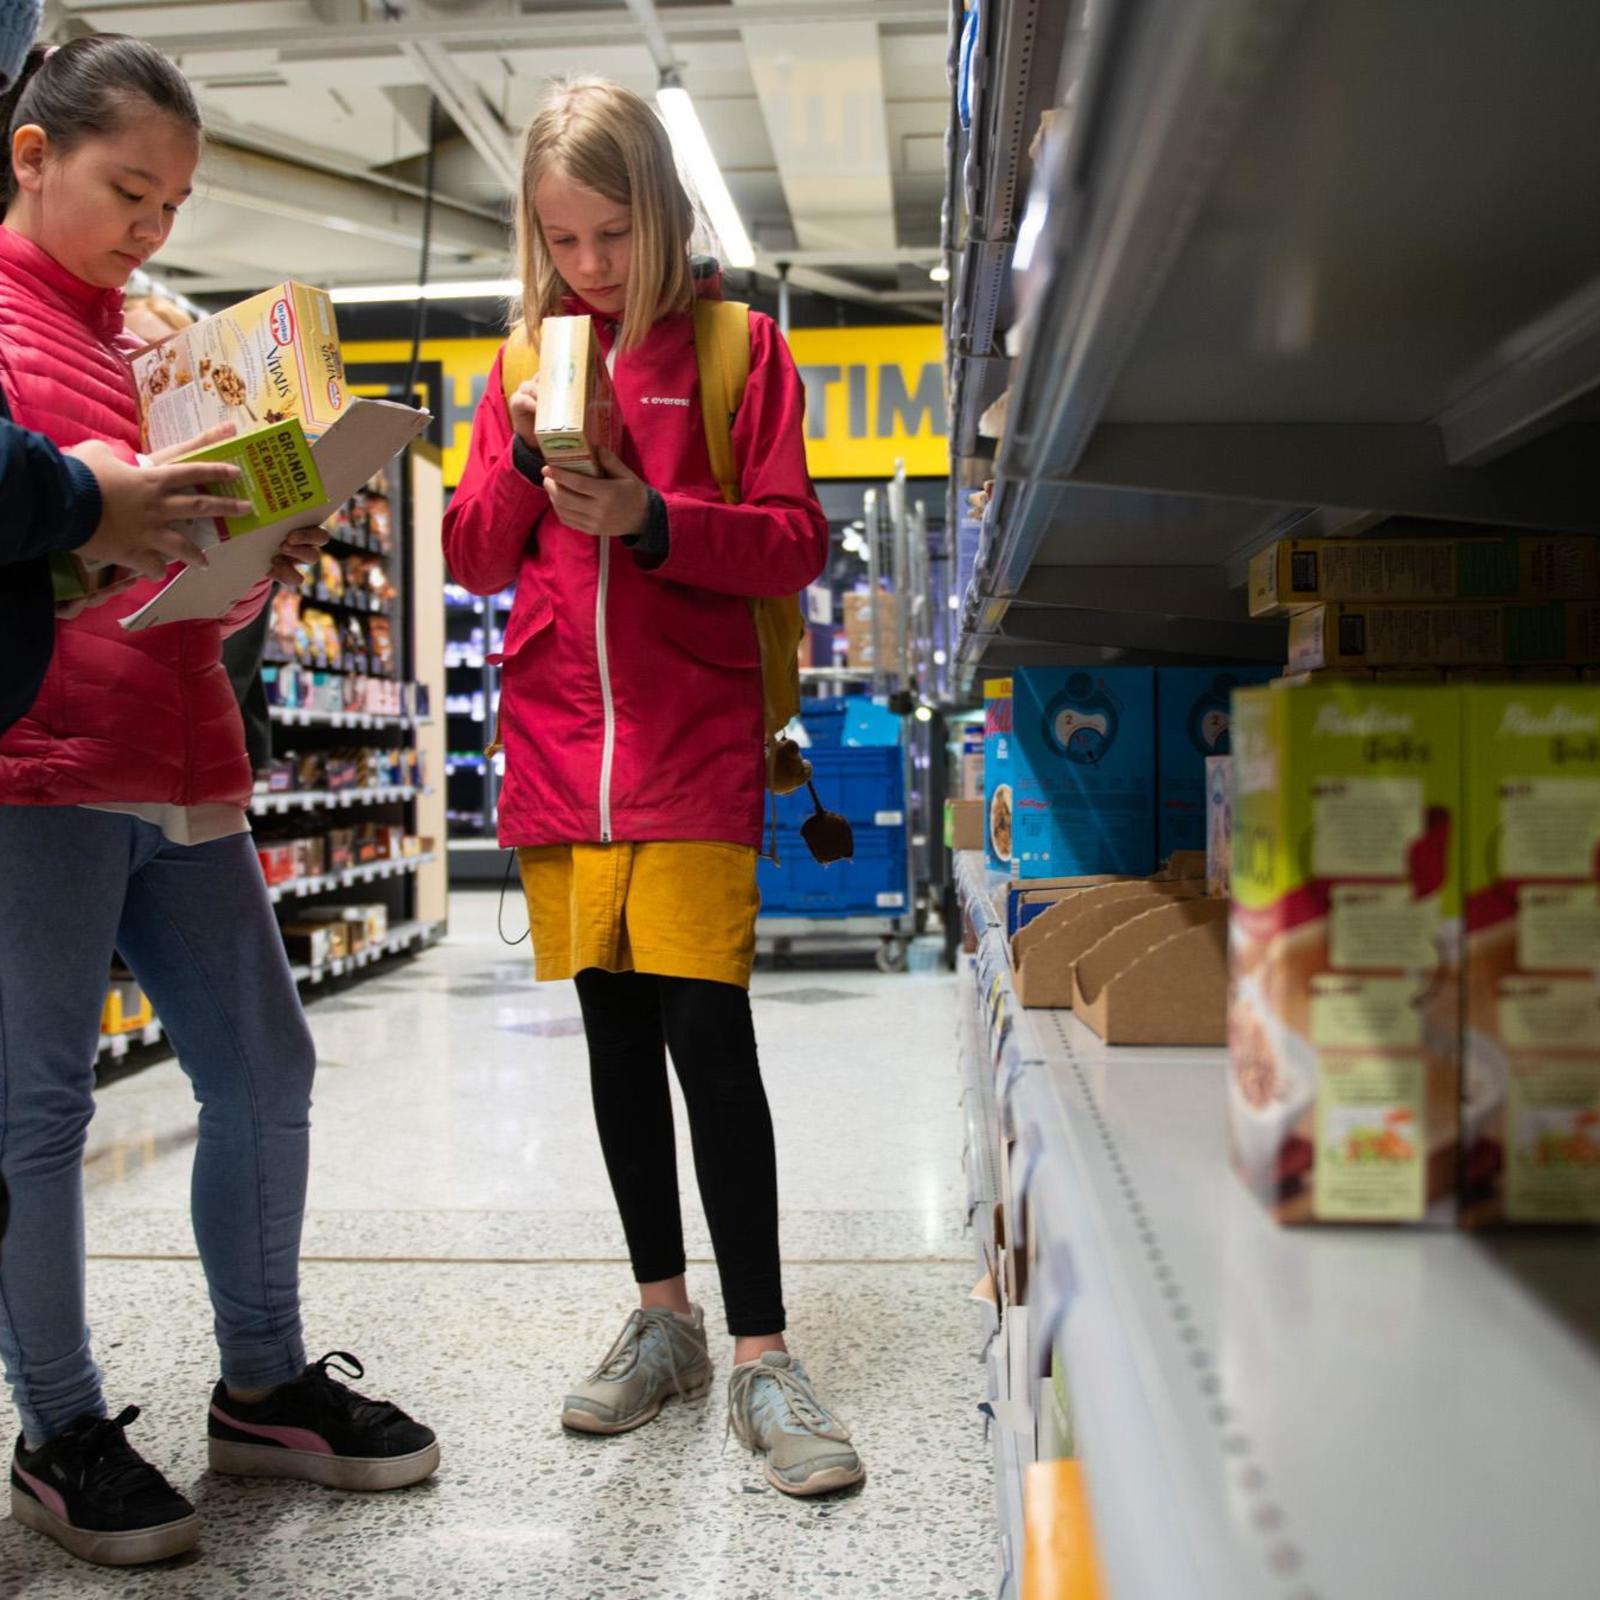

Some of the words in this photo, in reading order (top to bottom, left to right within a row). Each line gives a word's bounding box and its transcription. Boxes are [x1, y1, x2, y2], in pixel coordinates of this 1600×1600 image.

[256, 440, 269, 454] SE
[262, 454, 275, 471] ON
[277, 431, 314, 501] GRANOLA
[268, 472, 290, 510] JOTAIN
